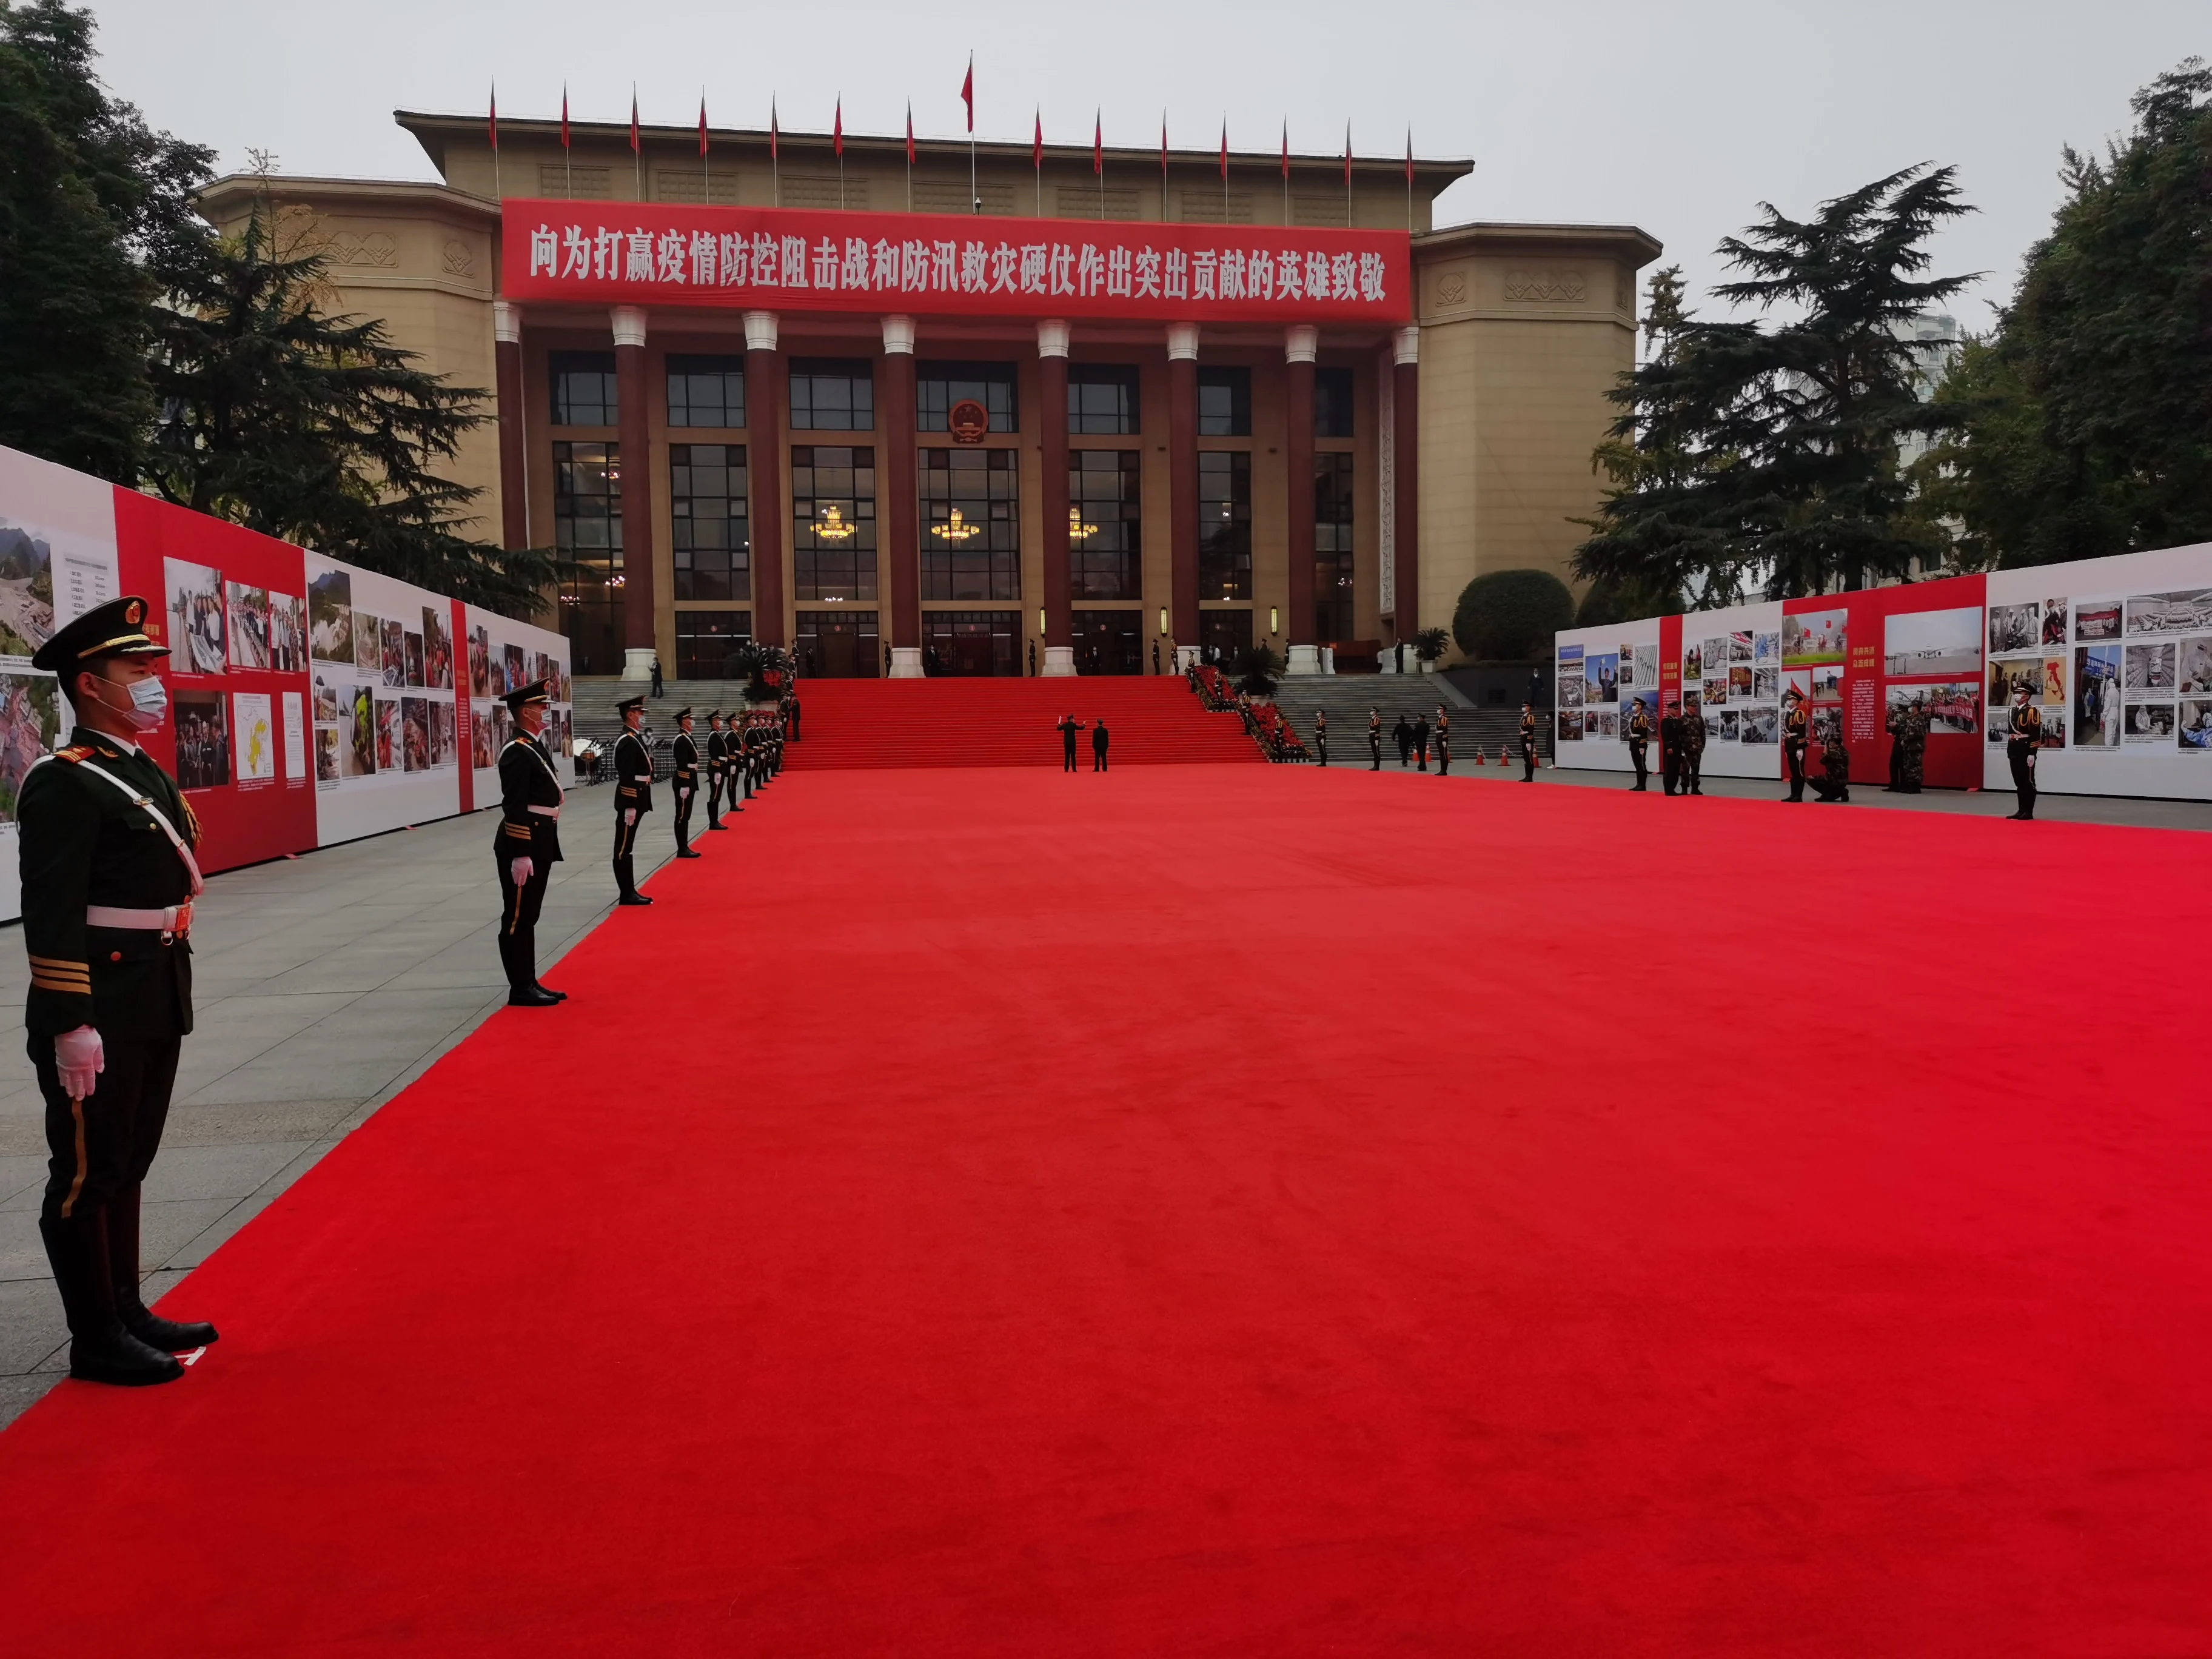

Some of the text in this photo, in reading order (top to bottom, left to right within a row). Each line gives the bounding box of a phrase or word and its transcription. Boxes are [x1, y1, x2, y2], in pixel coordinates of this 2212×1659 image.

[530, 223, 1386, 302] 向为打赢疫情防控阻击战和防汛救灾硬仗作出突出贡献的英雄致敬
